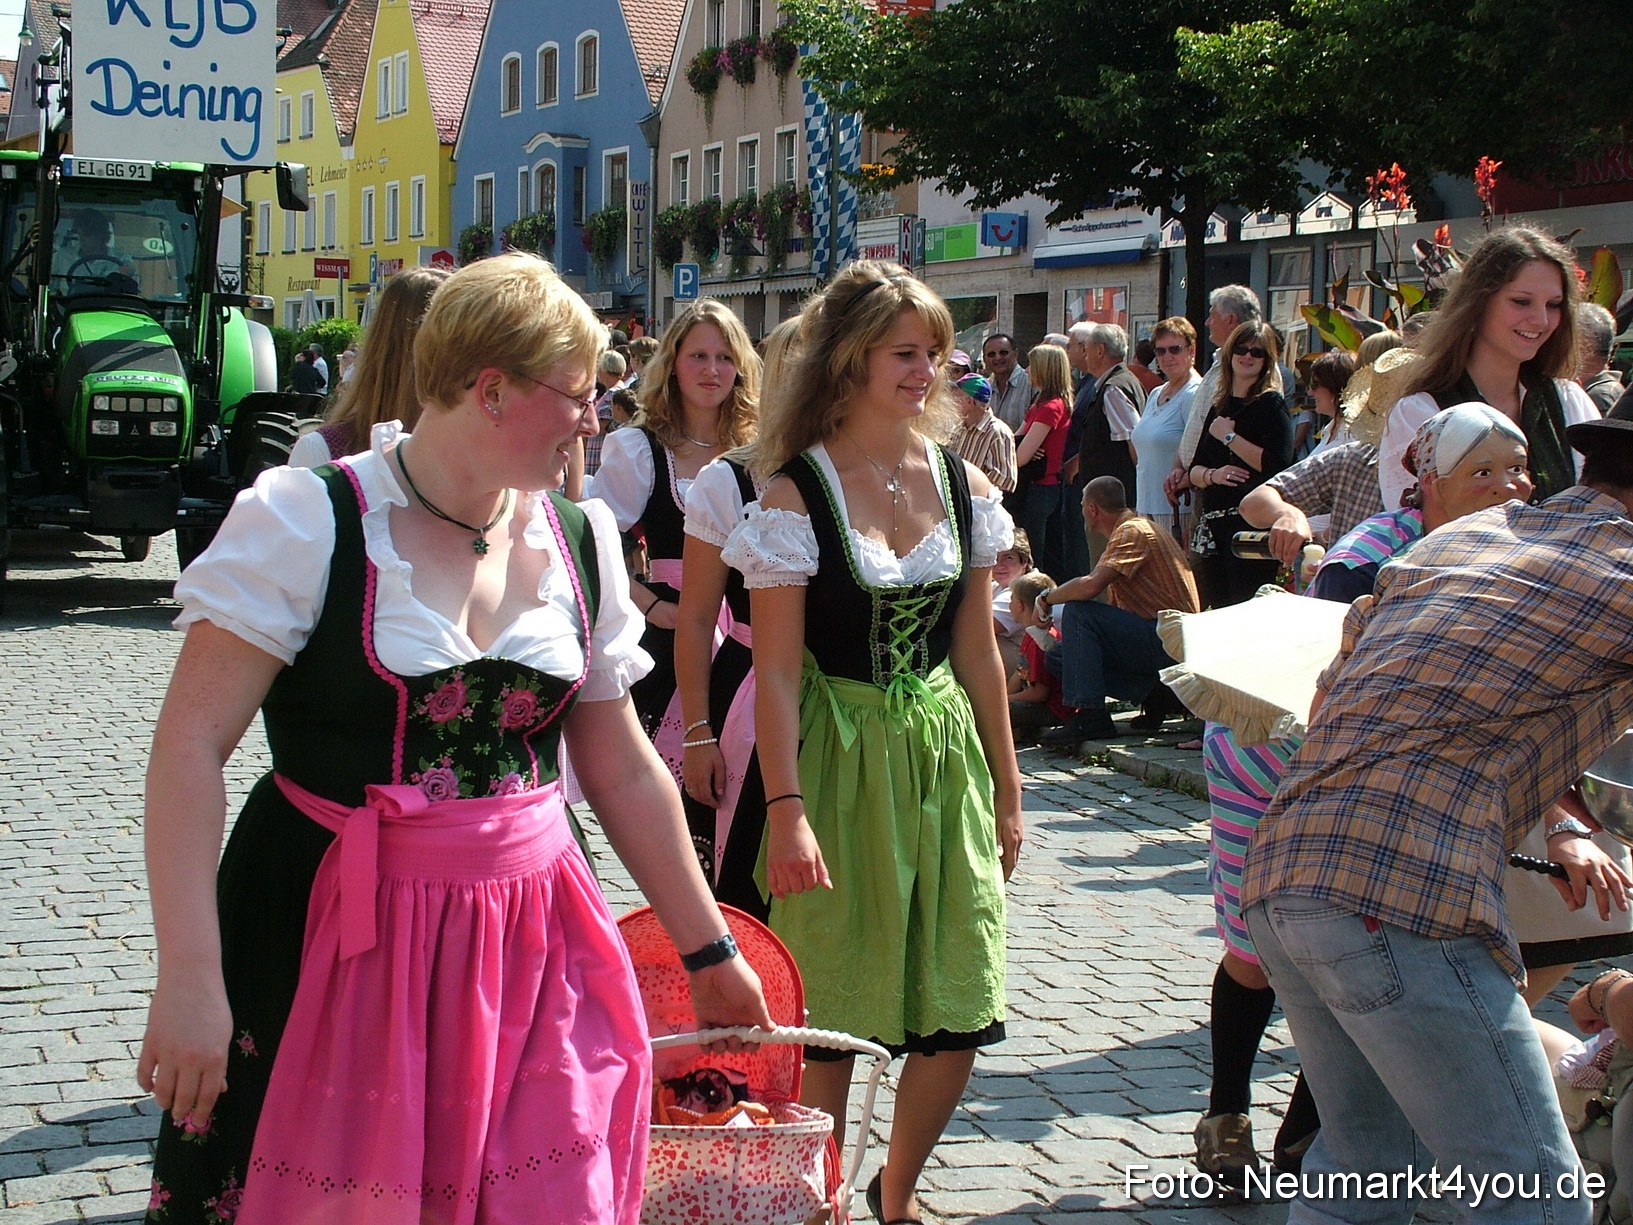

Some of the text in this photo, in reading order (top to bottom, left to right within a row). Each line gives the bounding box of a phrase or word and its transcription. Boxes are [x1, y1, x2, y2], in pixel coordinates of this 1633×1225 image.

[86, 58, 262, 160] Deining
[78, 161, 146, 179] EI GG 91
[320, 163, 348, 184] Lehmeier
[632, 199, 647, 269] WITTL
[864, 243, 896, 260] SIMPSONS
[287, 276, 322, 293] Restaurant
[679, 268, 694, 295] P
